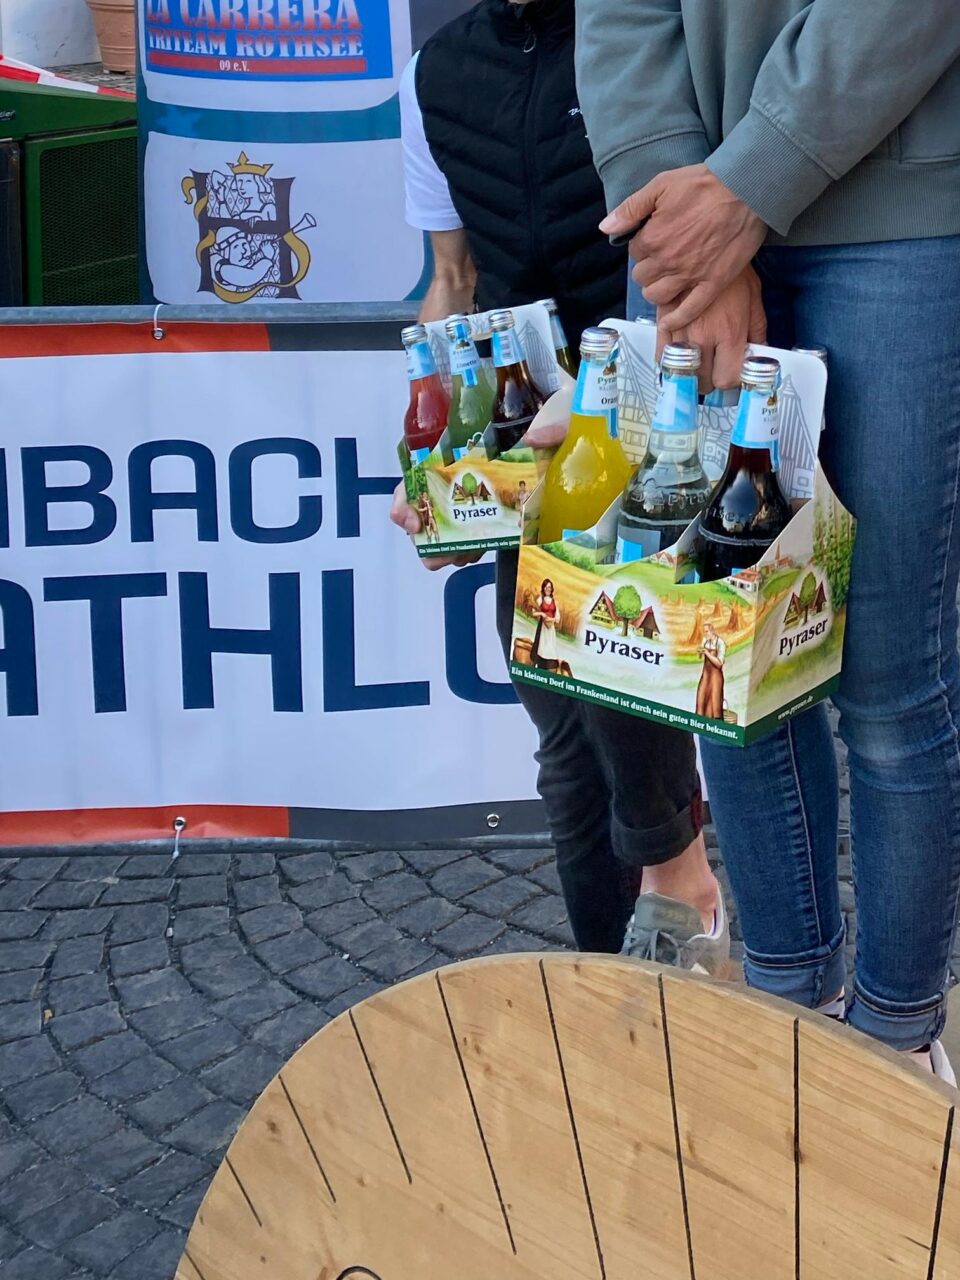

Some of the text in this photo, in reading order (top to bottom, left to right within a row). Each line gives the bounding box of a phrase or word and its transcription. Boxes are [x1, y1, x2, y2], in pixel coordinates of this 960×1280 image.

[148, 26, 364, 58] TRITEAM ROTHSEE
[219, 60, 250, 72] 09 e.V.
[0, 437, 403, 548] BACH
[453, 506, 498, 522] Pyraser
[584, 629, 664, 666] Pyraser
[779, 619, 828, 656] Pyraser
[511, 666, 738, 739] Ein kleines Dorf im Frankenland ist durch sein gutes Bier bekannt.
